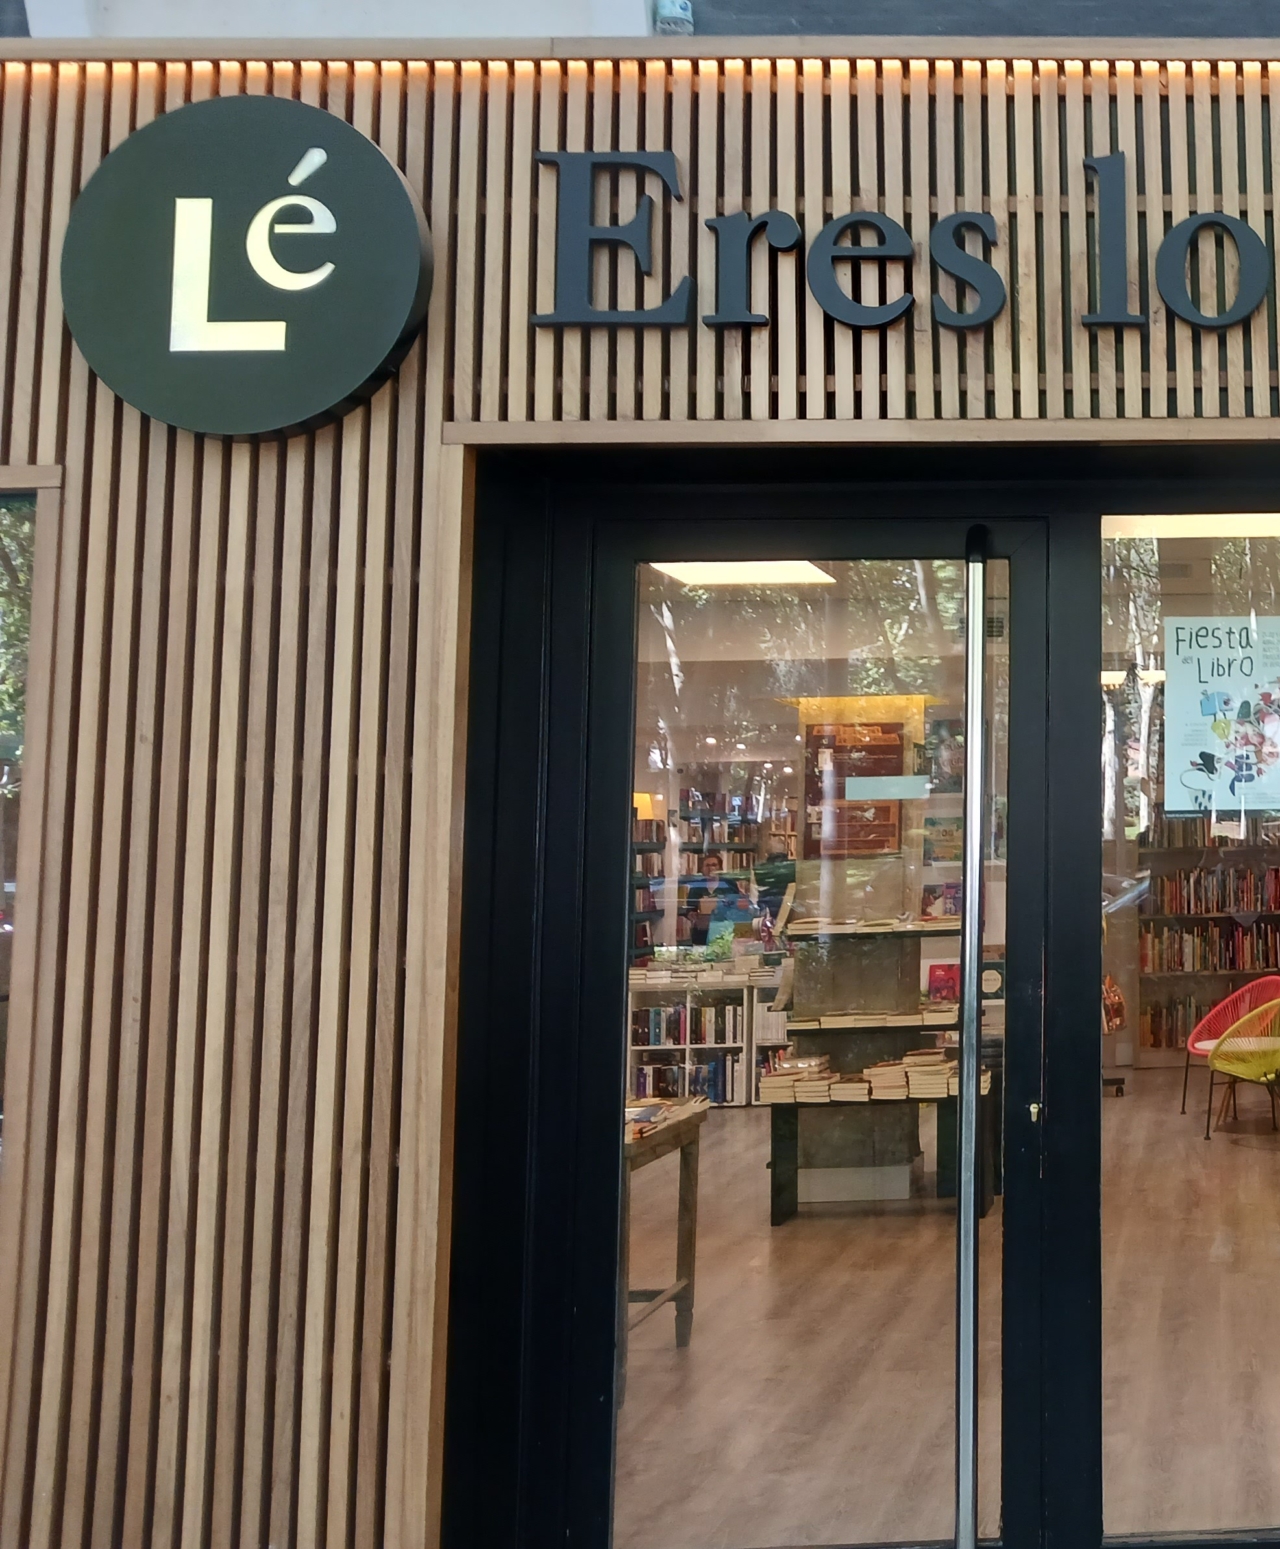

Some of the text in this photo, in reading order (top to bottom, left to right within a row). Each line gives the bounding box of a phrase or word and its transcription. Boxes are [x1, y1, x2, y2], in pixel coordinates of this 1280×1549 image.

[169, 147, 337, 353] Lé
[530, 150, 1007, 329] Eres
[1081, 150, 1269, 329] lo
[1175, 626, 1253, 655] Fiesta
